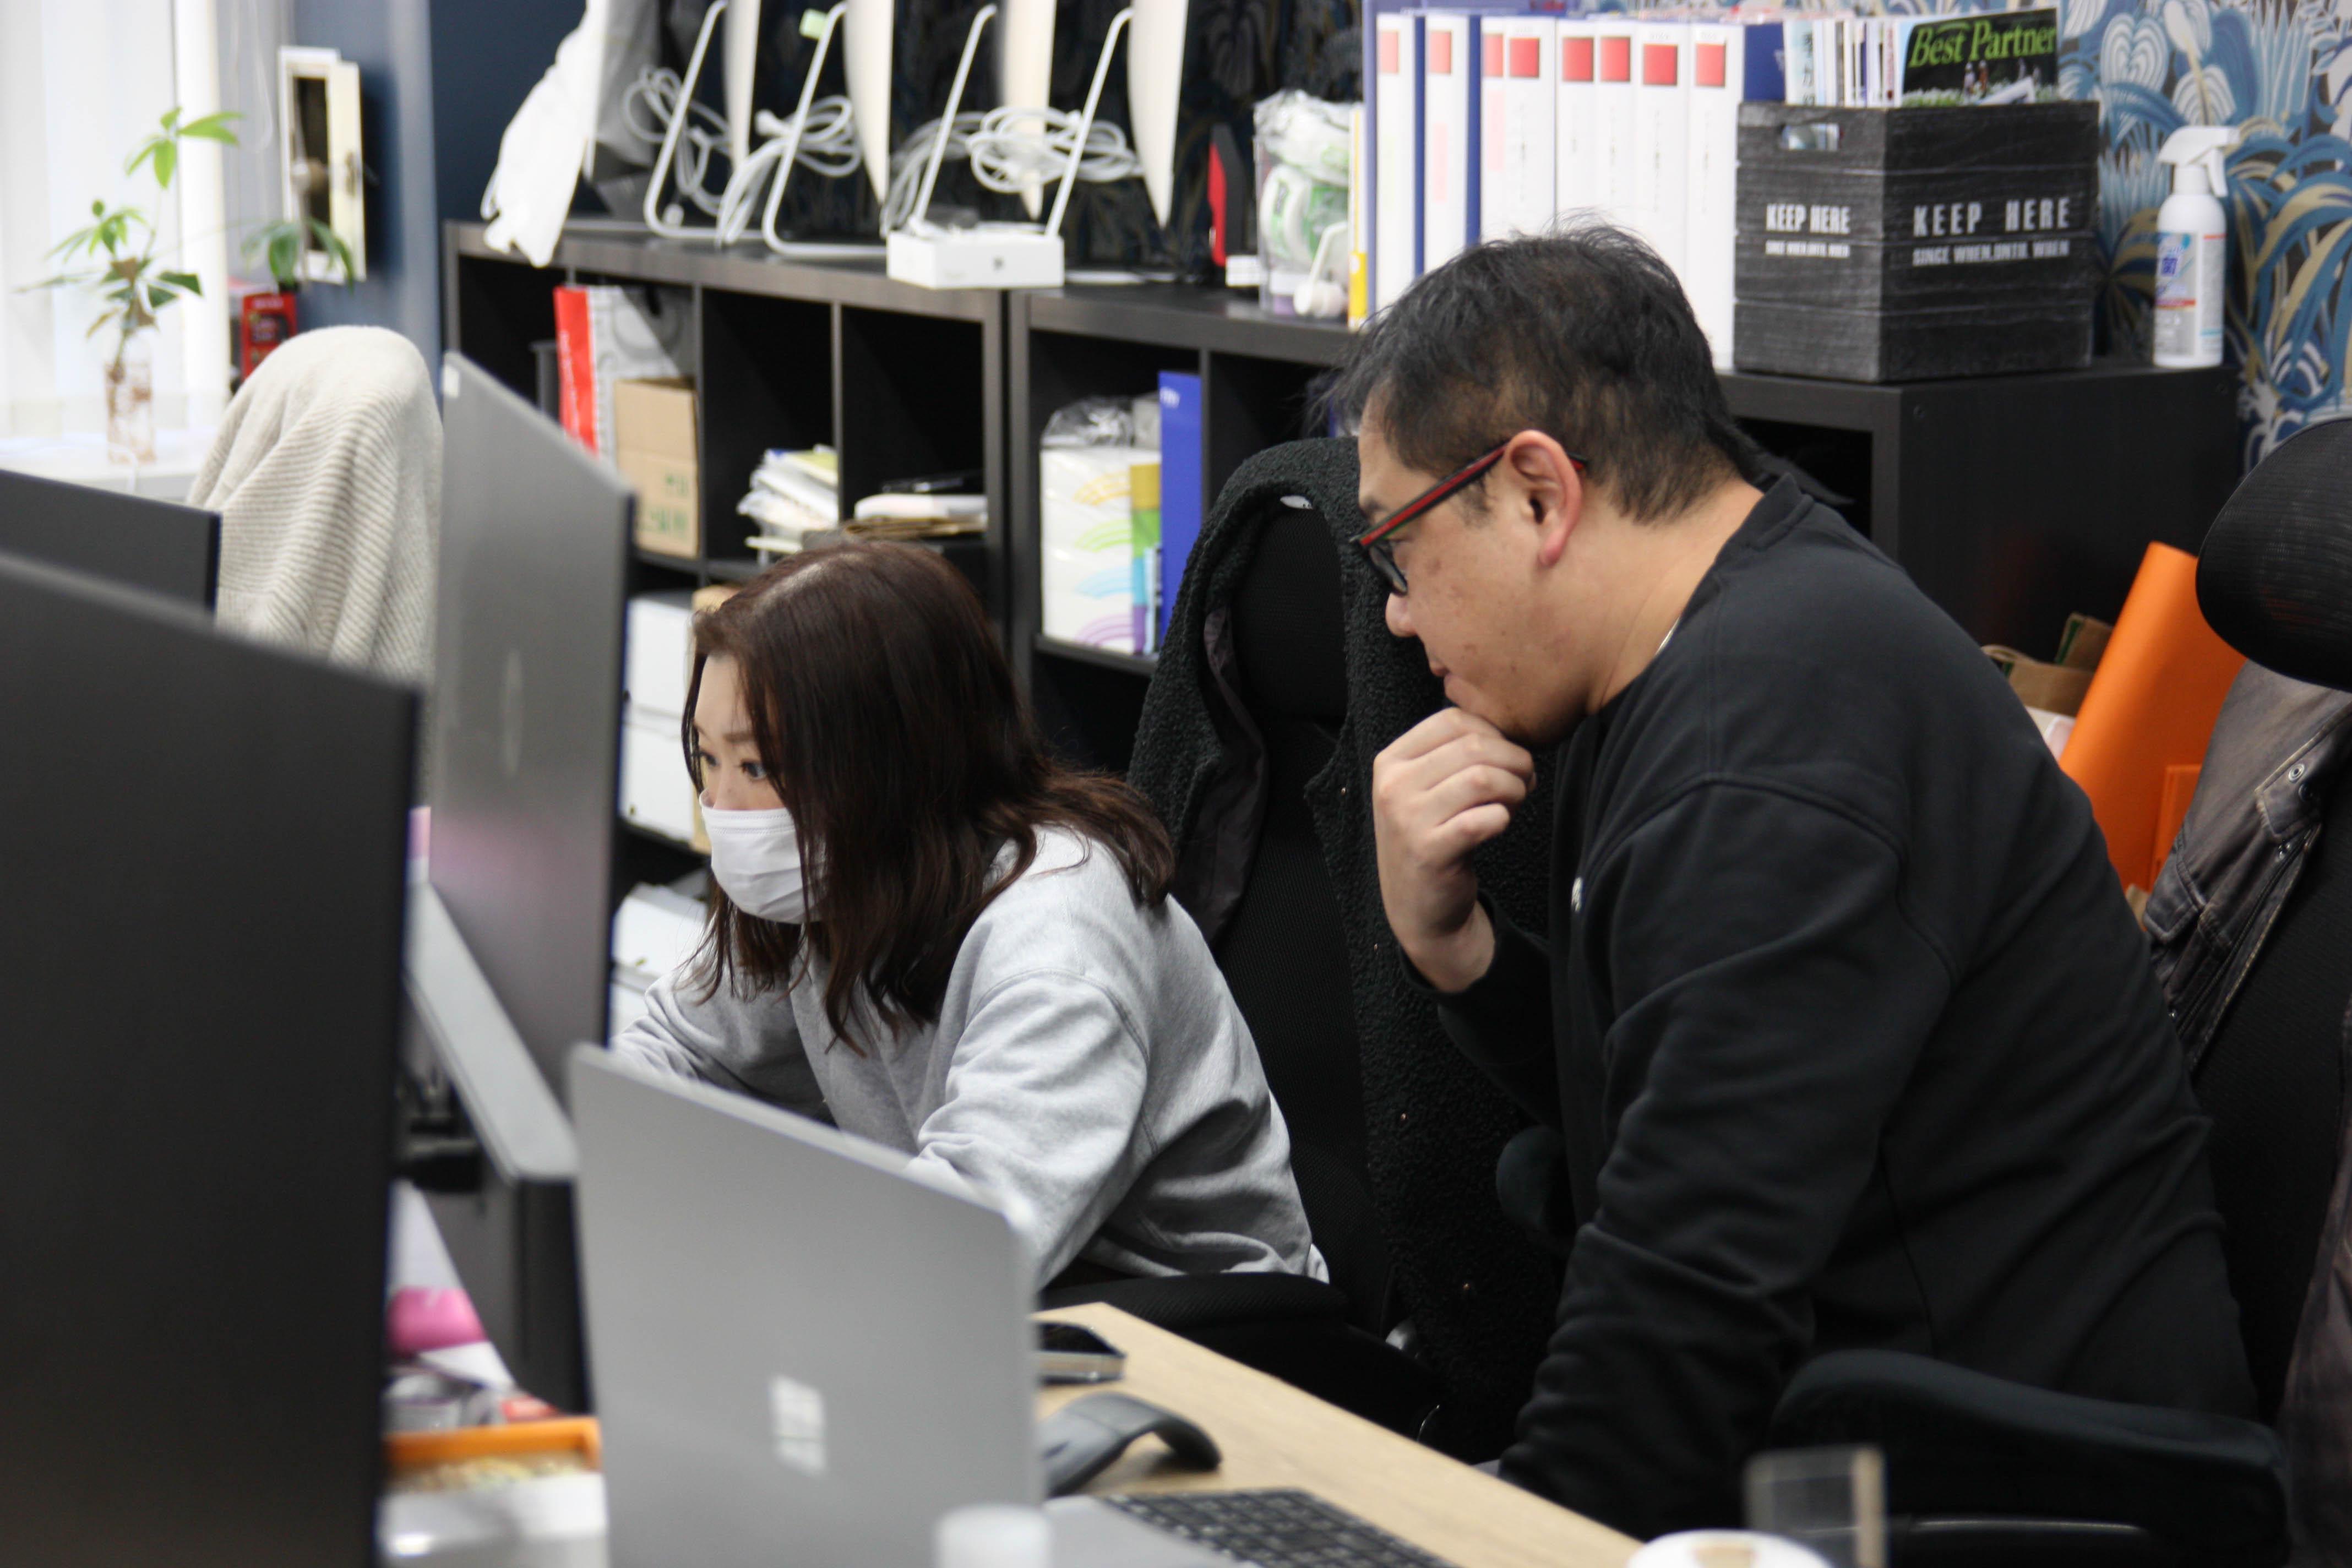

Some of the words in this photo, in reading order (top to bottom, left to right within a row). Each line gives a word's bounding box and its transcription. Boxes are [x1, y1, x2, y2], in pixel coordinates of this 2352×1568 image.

[1908, 26, 1967, 68] Best
[1969, 19, 2057, 62] Partner
[1765, 203, 1806, 232] KEEP
[1809, 204, 1851, 235] HERE
[1913, 201, 1982, 237] KEEP
[2005, 196, 2070, 232] HERE
